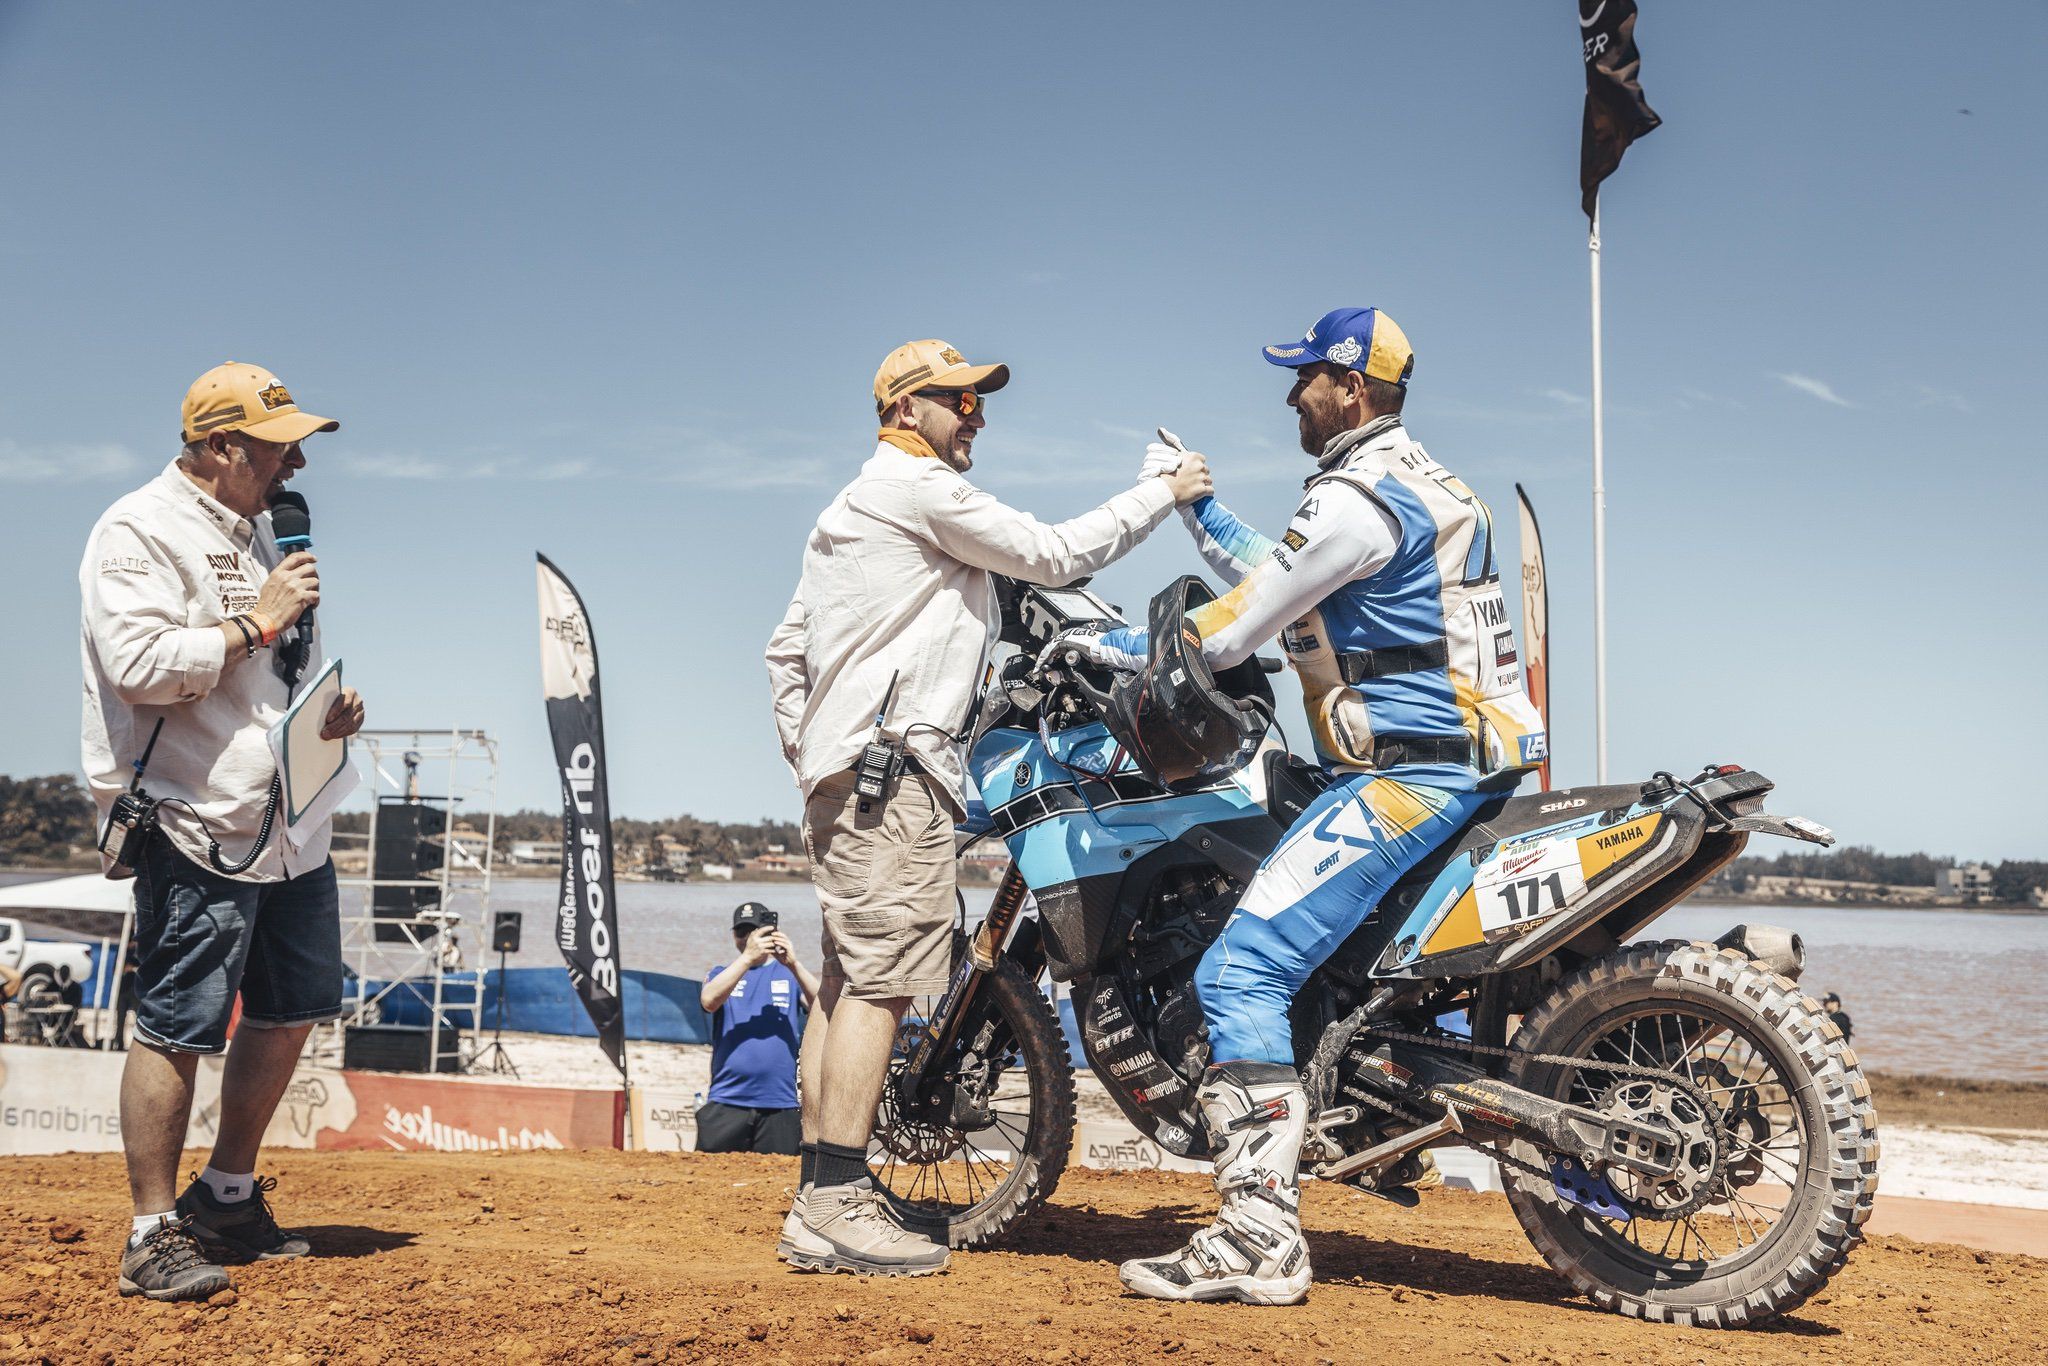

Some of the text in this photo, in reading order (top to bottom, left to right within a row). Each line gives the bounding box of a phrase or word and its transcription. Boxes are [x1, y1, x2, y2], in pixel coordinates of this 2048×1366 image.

[101, 557, 150, 569] BALTIC
[217, 572, 248, 582] MOTUL
[1540, 799, 1587, 814] SHAD
[1526, 820, 1586, 843] MICHELIN
[1597, 826, 1643, 850] YAMAHA
[1314, 850, 1341, 876] LEATT
[1502, 847, 1548, 874] Milwaukee
[1497, 872, 1567, 920] 171
[943, 968, 966, 1016] MICHELIN
[1098, 1011, 1122, 1027] motards
[1095, 1025, 1134, 1054] GYTR
[1117, 1050, 1155, 1074] YAMAHA
